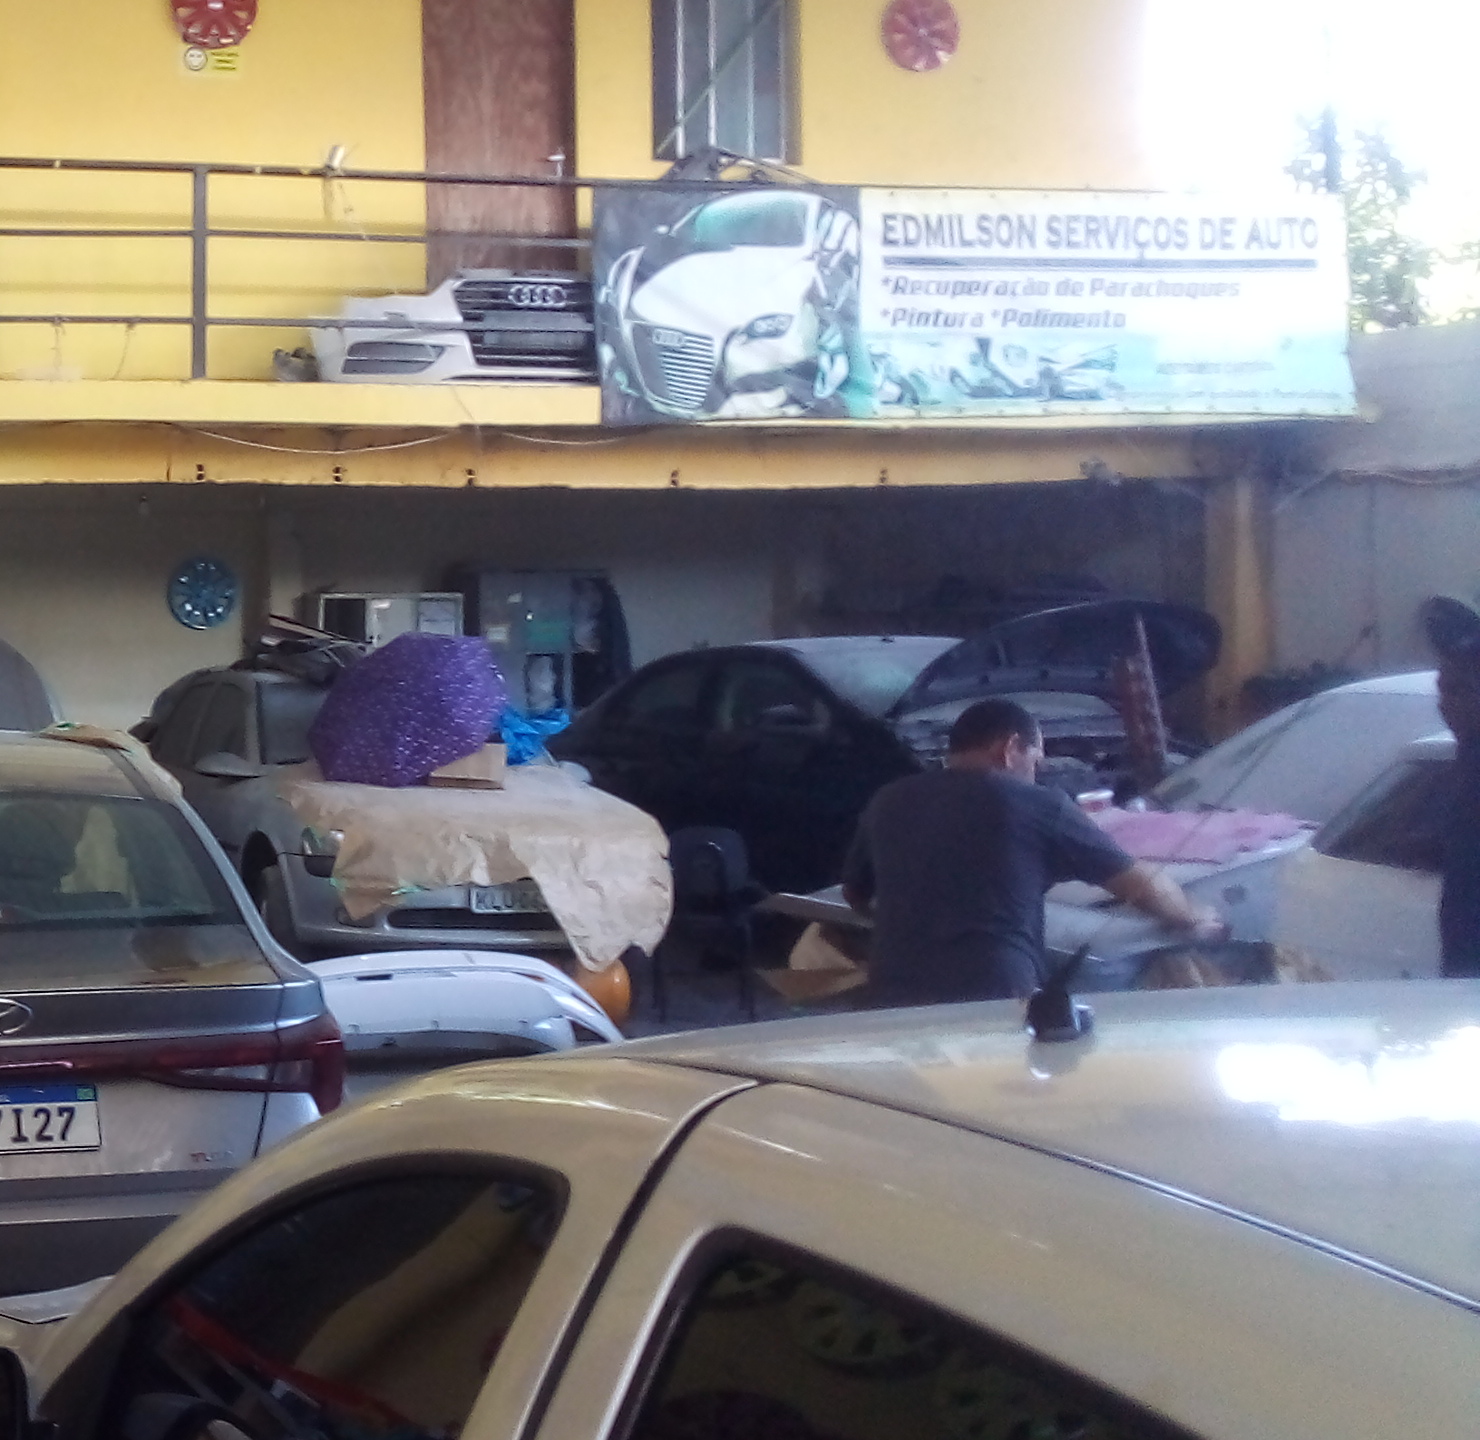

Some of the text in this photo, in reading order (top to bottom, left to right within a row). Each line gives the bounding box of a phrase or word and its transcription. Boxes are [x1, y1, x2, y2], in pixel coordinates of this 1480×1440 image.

[881, 212, 1319, 258] EDMILSON SERVIÇOS DE AUTO
[1055, 277, 1085, 297] de
[1089, 277, 1240, 299] Parachoques
